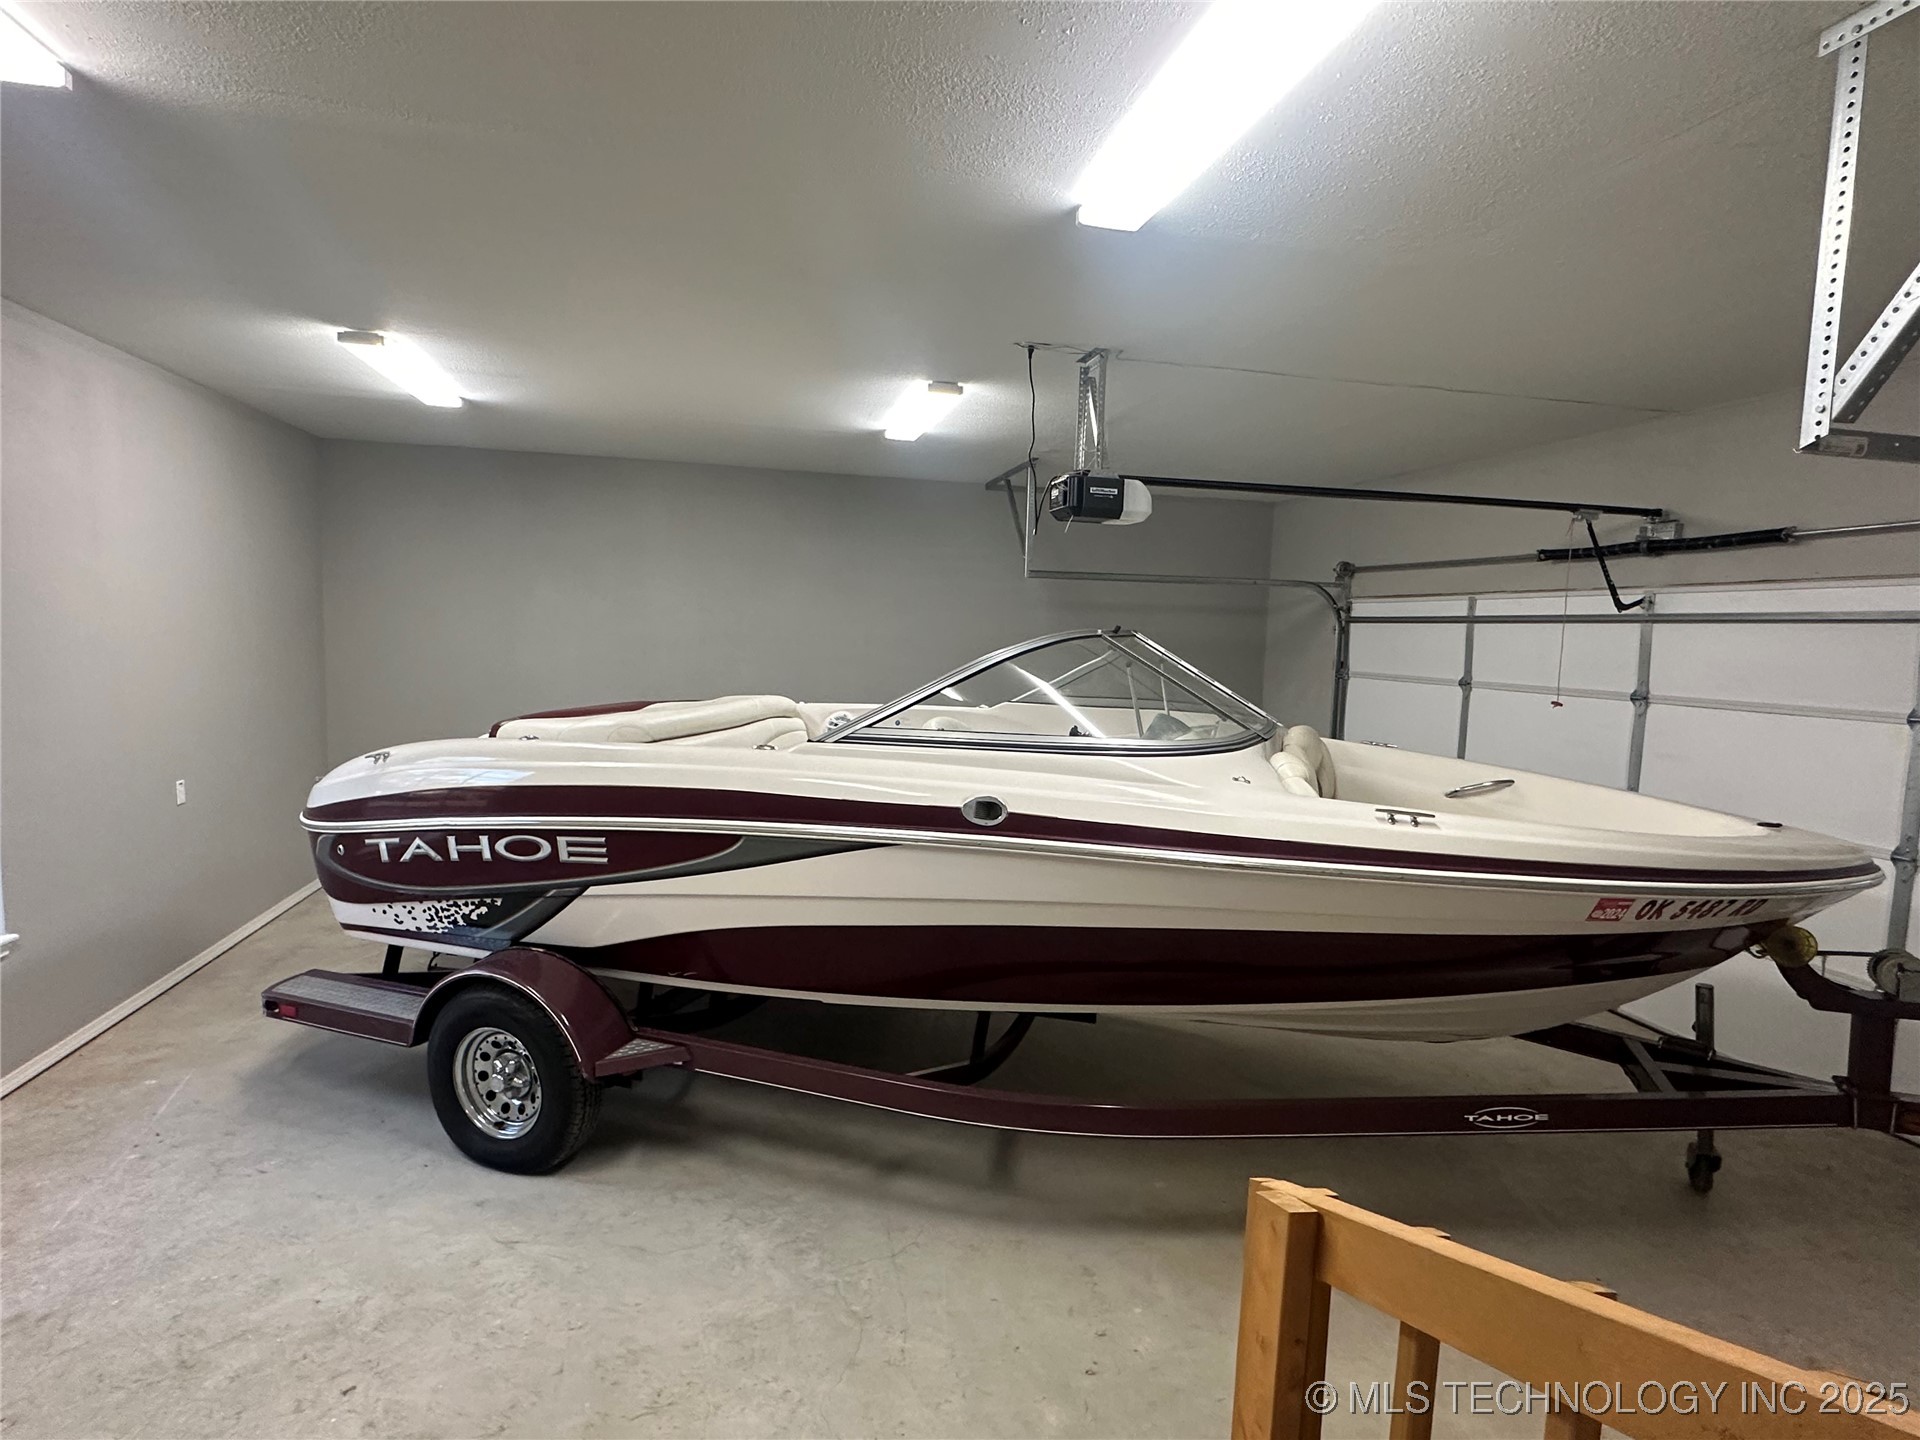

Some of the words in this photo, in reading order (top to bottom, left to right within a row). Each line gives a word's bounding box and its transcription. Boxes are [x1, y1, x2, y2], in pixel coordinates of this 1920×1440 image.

[364, 834, 609, 864] TAHOE
[1599, 907, 1628, 920] 2024
[1634, 899, 1675, 921] OK
[1464, 1113, 1549, 1122] TAHOE
